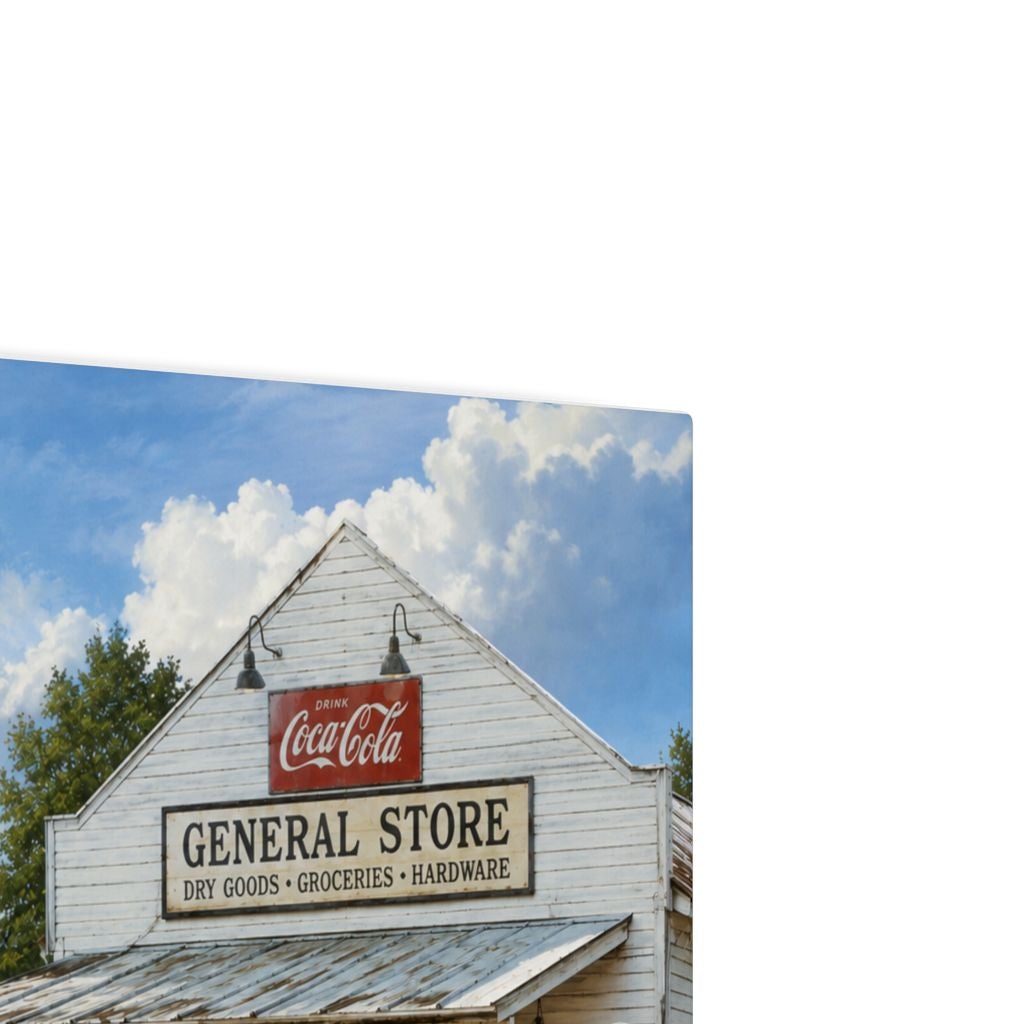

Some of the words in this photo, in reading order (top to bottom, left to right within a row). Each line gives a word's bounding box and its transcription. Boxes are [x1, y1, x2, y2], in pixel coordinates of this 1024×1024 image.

[315, 698, 349, 711] DRINK
[279, 701, 409, 772] Coca-Cola
[182, 811, 360, 868] GENERAL
[379, 798, 510, 854] STORE
[183, 878, 217, 901] DRY
[223, 874, 280, 898] GOODS
[297, 866, 394, 893] GROCERIES
[411, 857, 511, 885] HARDWARE
